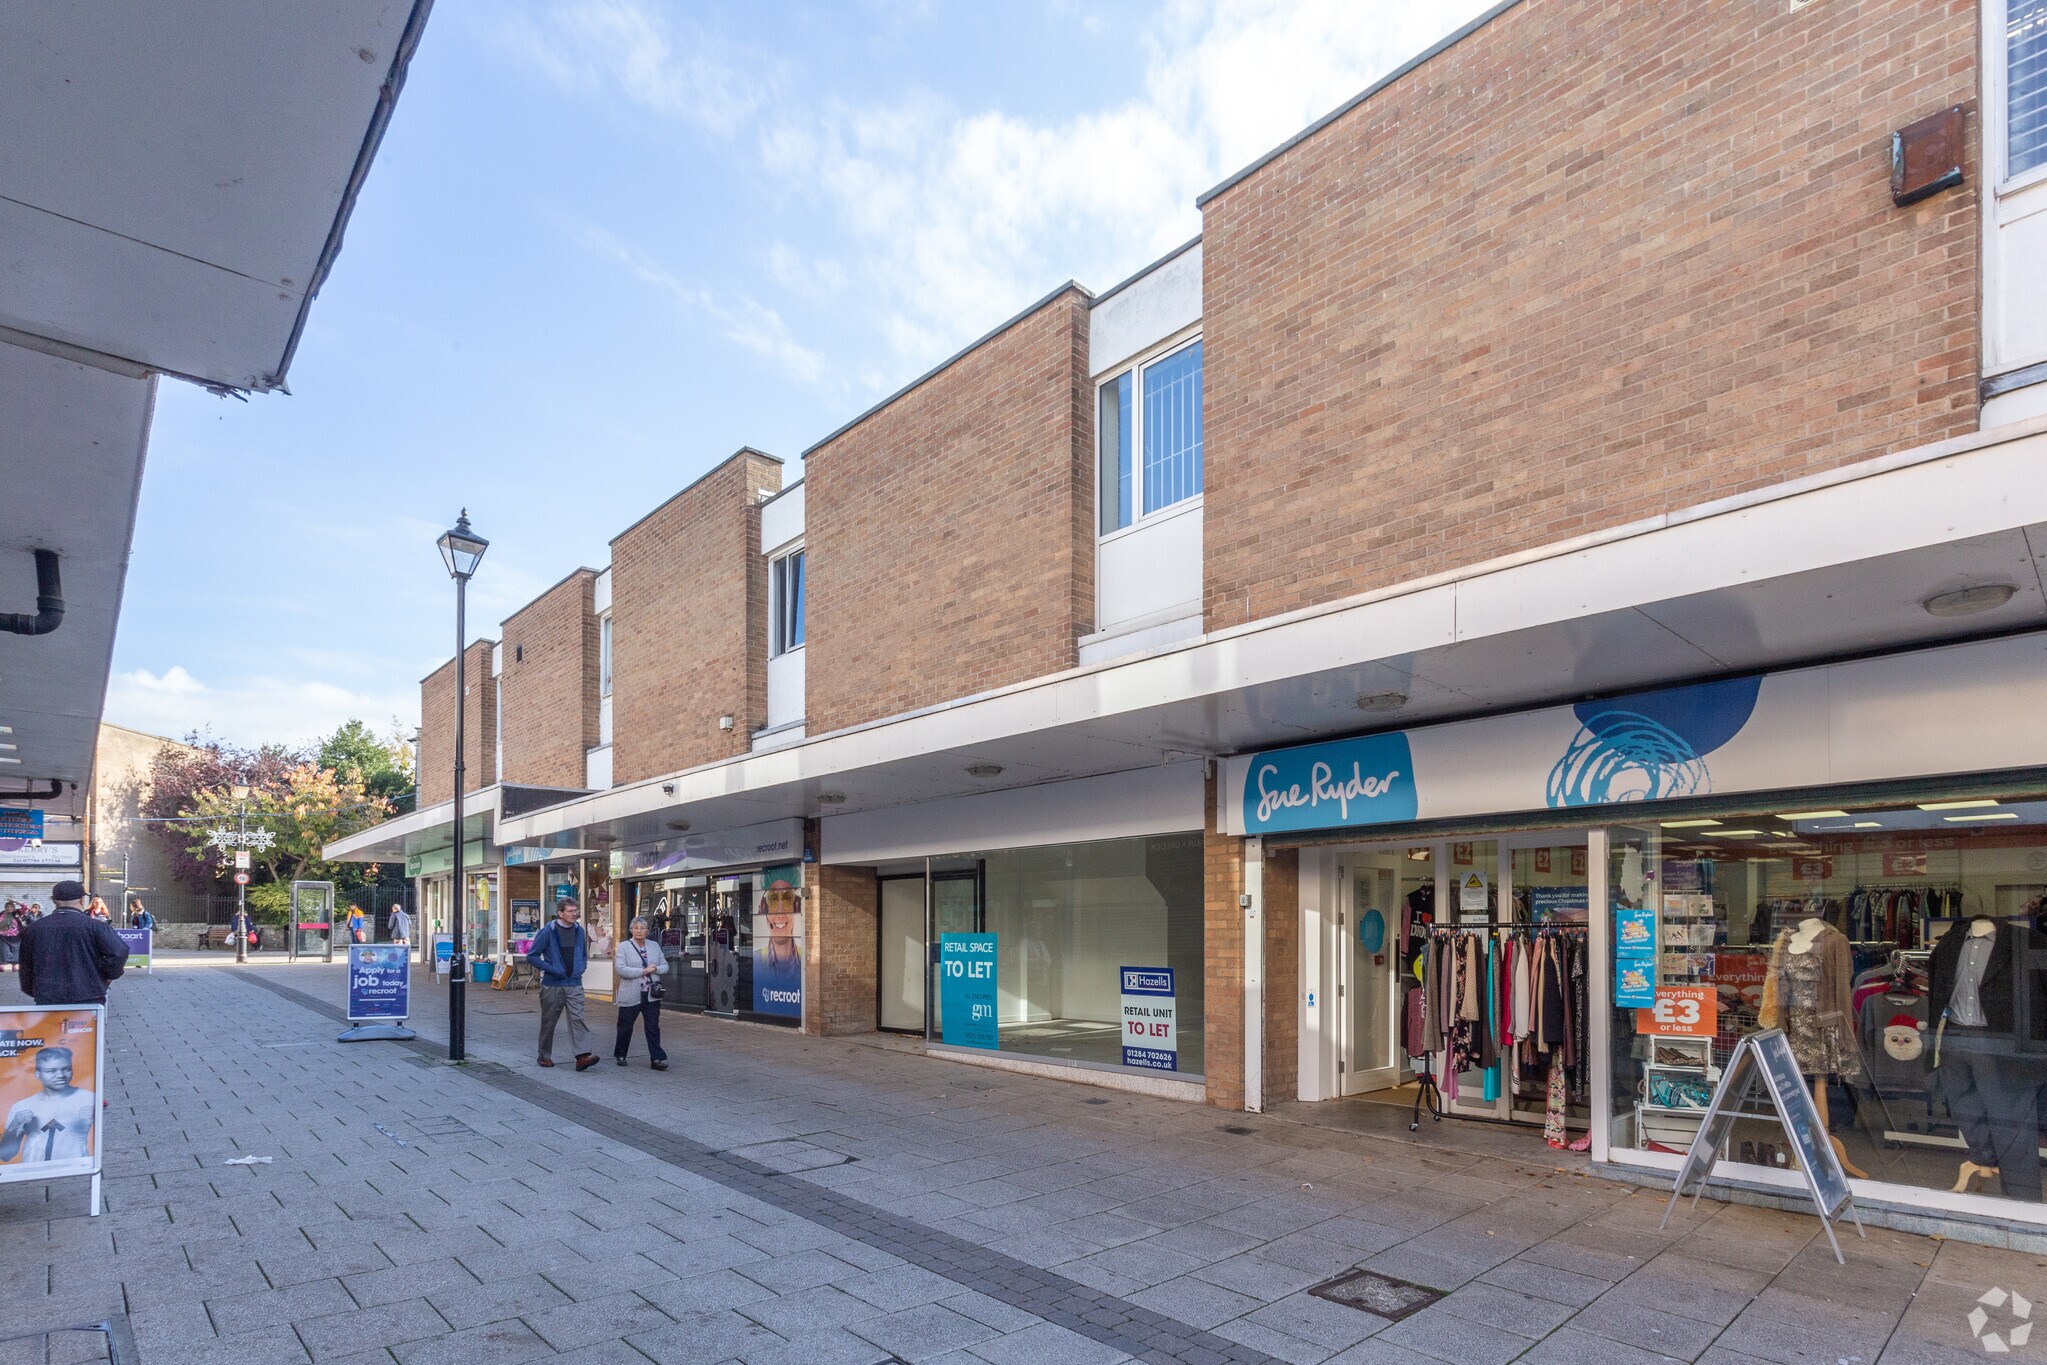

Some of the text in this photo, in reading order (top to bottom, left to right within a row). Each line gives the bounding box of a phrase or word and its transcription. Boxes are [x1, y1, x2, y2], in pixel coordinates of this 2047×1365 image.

[1257, 761, 1400, 822] Sue Ryder
[756, 840, 788, 853] recroot.net
[1896, 840, 1912, 849] or
[1919, 837, 1954, 848] less
[1801, 862, 1824, 874] £3
[945, 942, 993, 953] RETAIL SPACE
[359, 966, 385, 975] Apply
[945, 960, 993, 978] TO LET
[353, 975, 379, 989] job
[1138, 975, 1167, 987] Hazells
[770, 988, 801, 1003] recroot
[1653, 990, 1704, 1000] verything
[972, 1003, 992, 1022] gm
[1124, 1006, 1172, 1018] RETAIL UNIT
[1652, 998, 1700, 1024] £3
[1127, 1021, 1169, 1037] TO LET
[1672, 1023, 1693, 1032] less
[17, 1039, 44, 1047] NOW.
[1127, 1049, 1172, 1061] 01284 702626
[1127, 1057, 1172, 1069] hazells.co.uk
